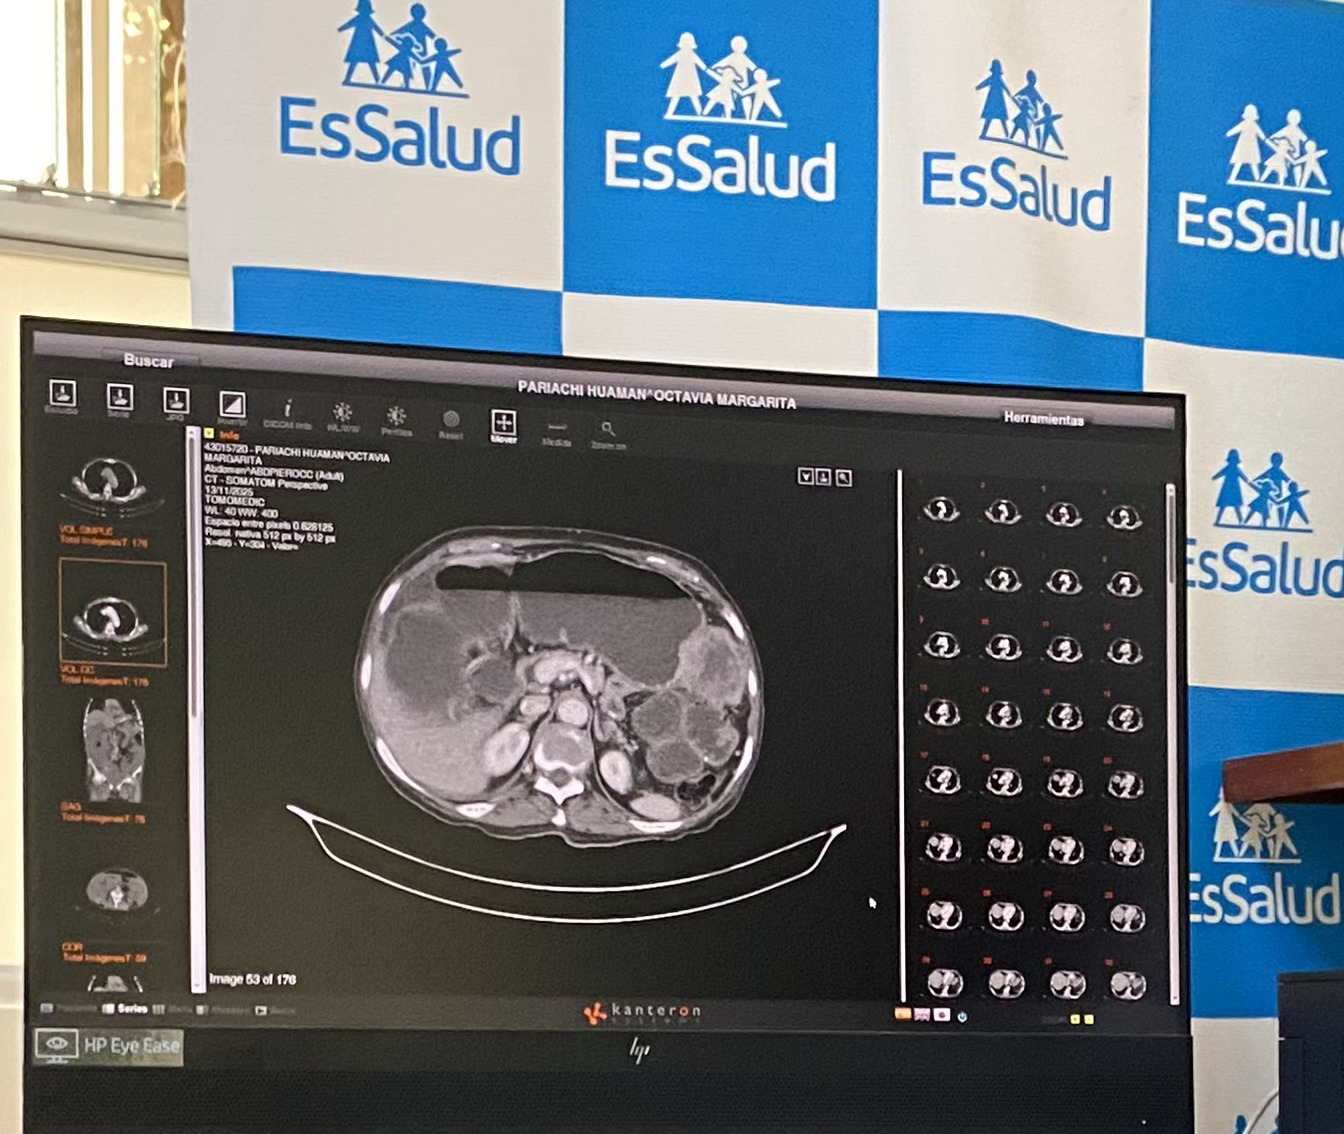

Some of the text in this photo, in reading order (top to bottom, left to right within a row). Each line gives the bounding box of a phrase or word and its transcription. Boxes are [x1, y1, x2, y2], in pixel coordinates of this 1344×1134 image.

[279, 95, 520, 176] EsSalud
[605, 129, 837, 202] EsSalud
[922, 151, 1112, 233] EsSalud
[124, 352, 175, 369] Buscar
[518, 379, 584, 397] PARIACHI
[717, 393, 797, 410] MARGARITA
[1004, 410, 1085, 428] Herramientas
[490, 434, 518, 445] Mover
[255, 445, 301, 457] PARIACHI
[204, 453, 262, 466] MARGARITA
[204, 475, 218, 484] CT
[226, 476, 275, 488] SOMATOM
[205, 494, 265, 507] TOMOMEDIC
[263, 530, 280, 540] 512
[293, 532, 305, 543] by
[306, 532, 323, 543] 512
[209, 973, 244, 986] Image
[246, 974, 260, 984] 53
[262, 974, 273, 984] of
[118, 1004, 148, 1014] Series
[612, 1002, 701, 1016] kanteron
[85, 1036, 180, 1055] HP Eye Ease
